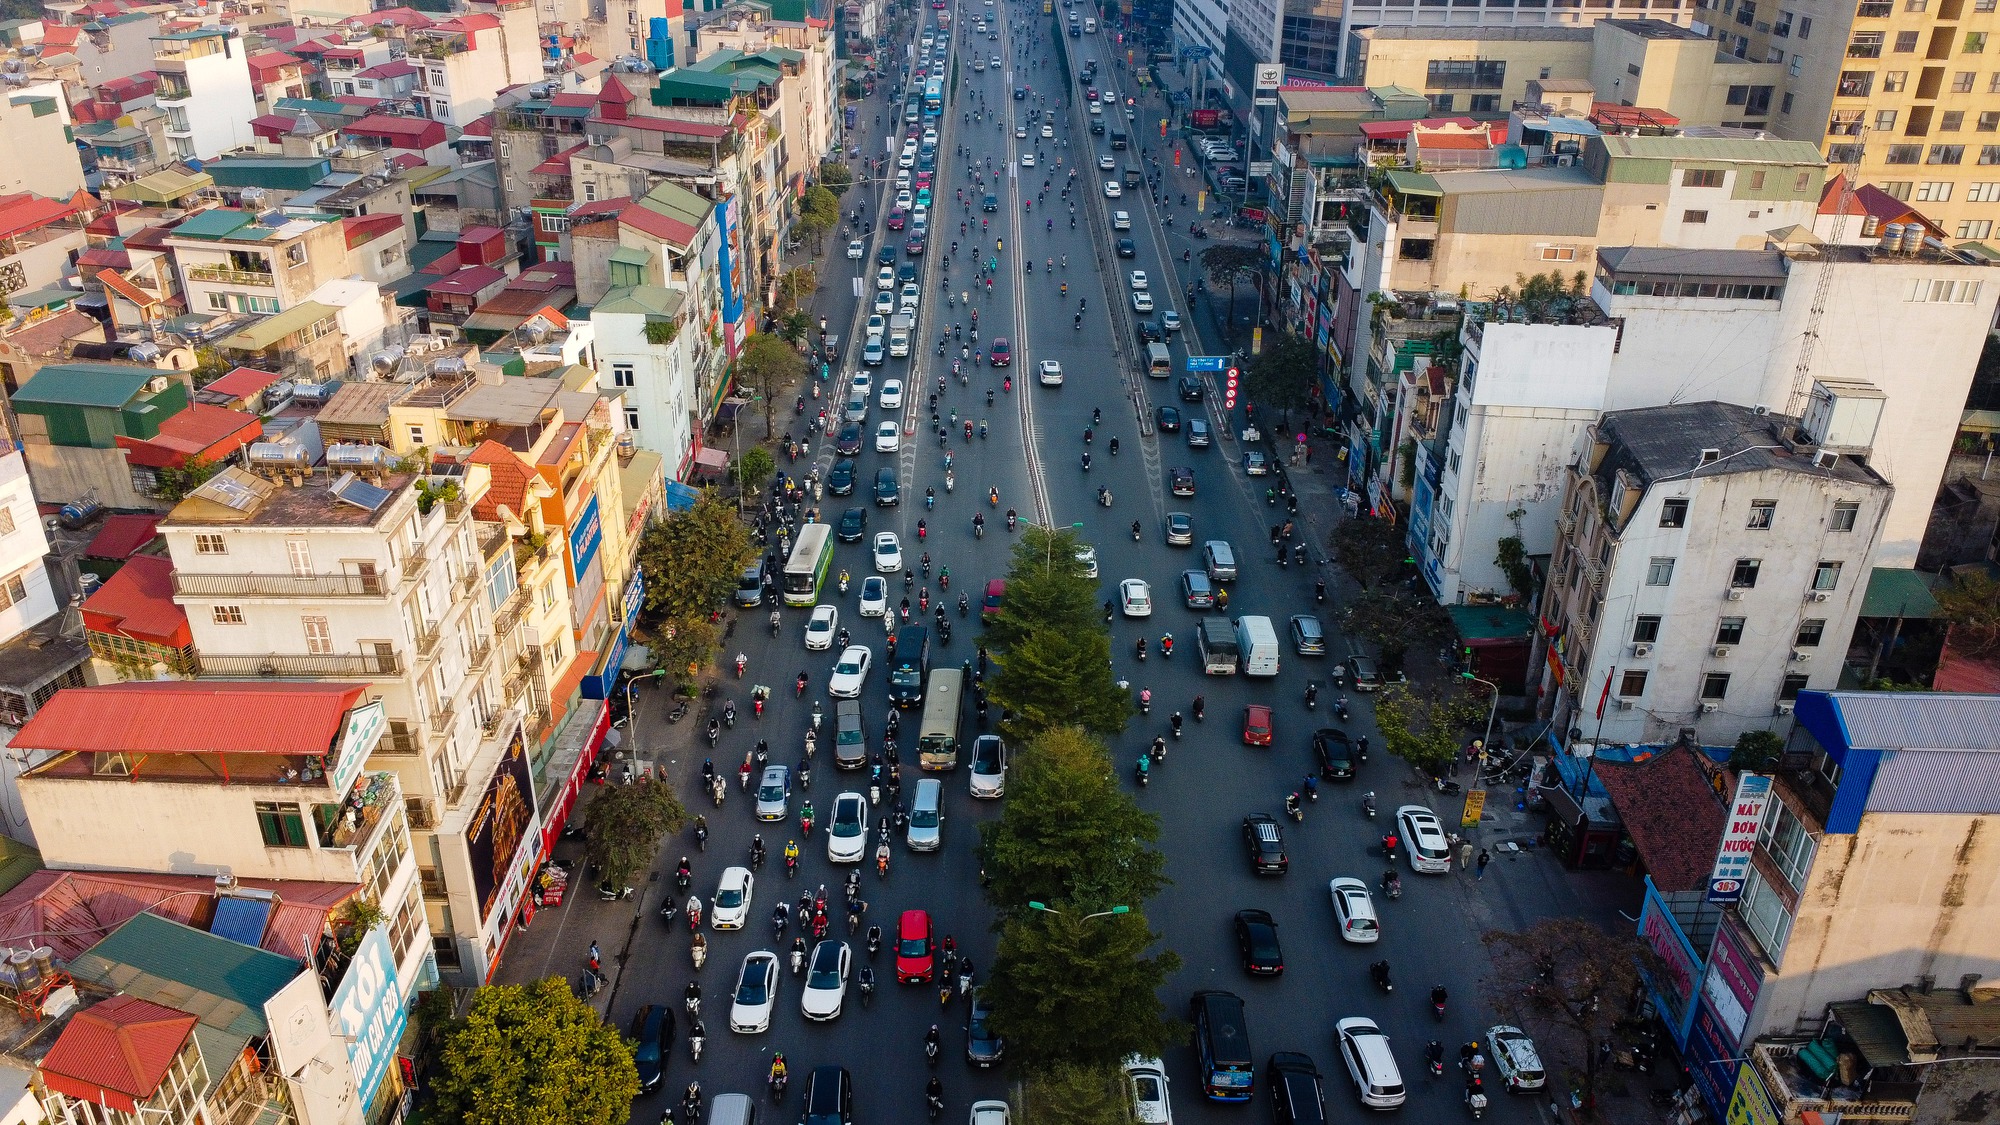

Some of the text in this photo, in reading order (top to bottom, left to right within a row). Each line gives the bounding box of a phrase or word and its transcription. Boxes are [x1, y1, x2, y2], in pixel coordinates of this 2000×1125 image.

[1187, 48, 1206, 57] Ford
[1288, 78, 1322, 87] TOYO
[1736, 800, 1762, 816] MÁY
[1731, 820, 1758, 834] BƠM
[1723, 837, 1755, 852] NƯỚC
[340, 941, 385, 1038] XÔI
[369, 1006, 386, 1054] CAY
[382, 980, 399, 1026] 628
